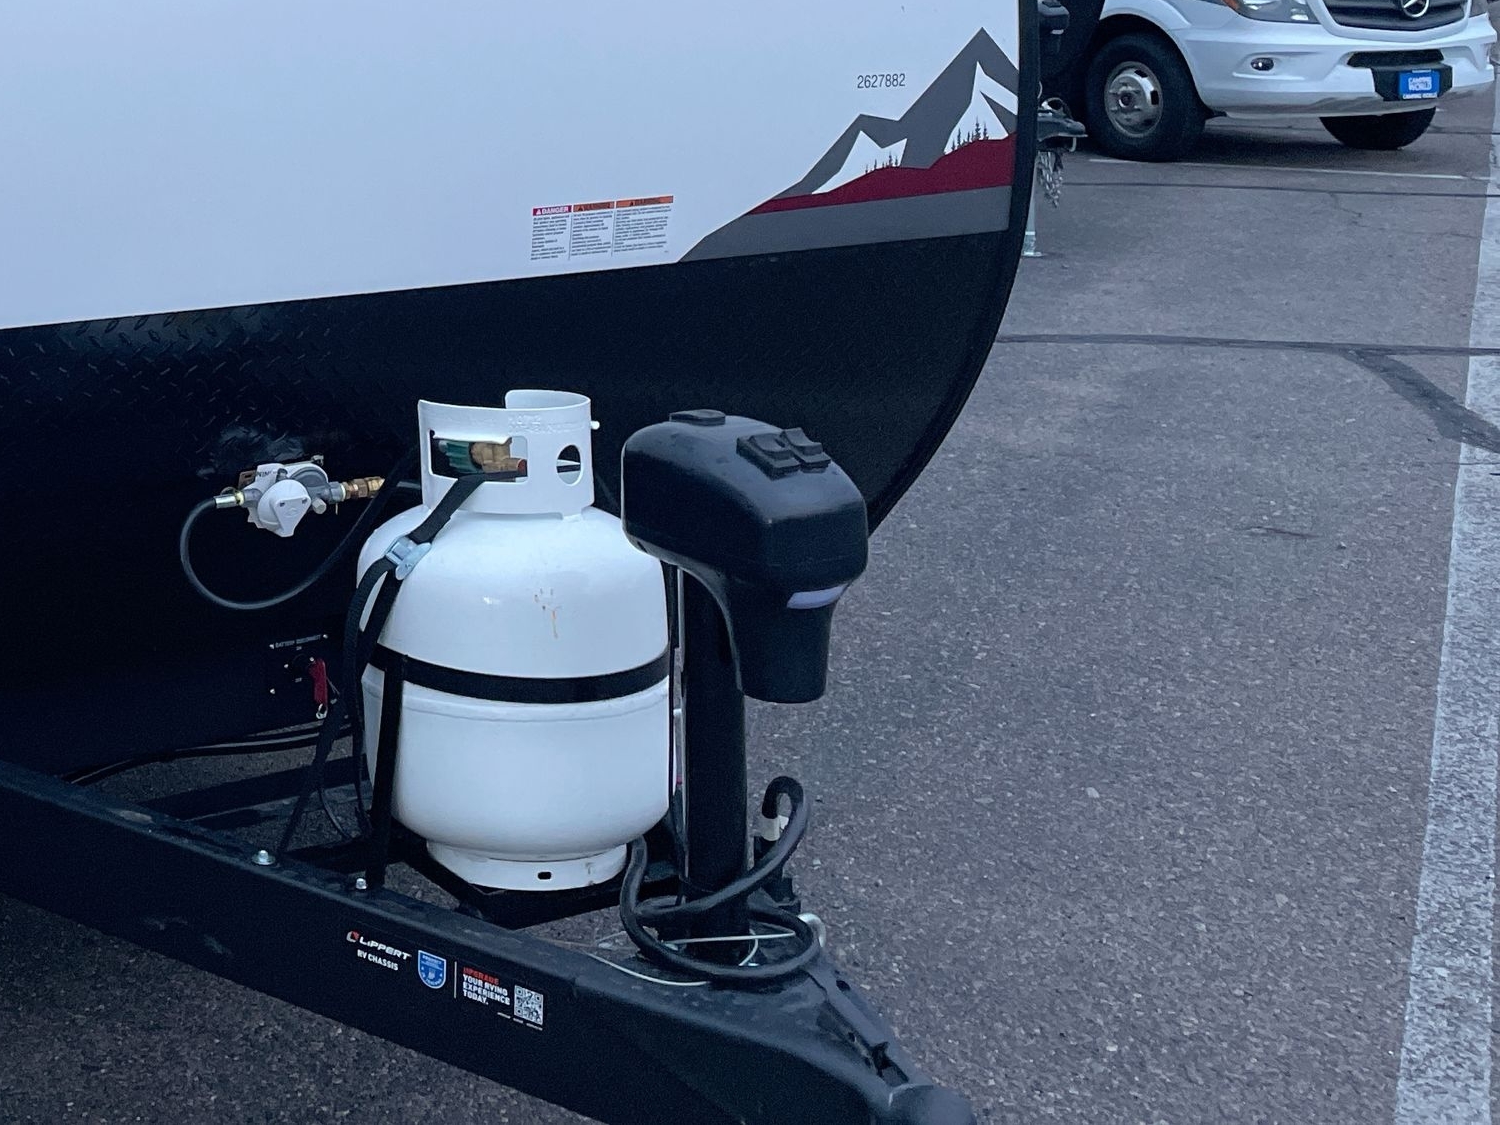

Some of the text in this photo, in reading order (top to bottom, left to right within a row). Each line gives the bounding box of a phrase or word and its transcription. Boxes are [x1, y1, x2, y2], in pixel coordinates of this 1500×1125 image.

[857, 73, 906, 88] 2627882
[541, 206, 569, 216] DANGER
[359, 936, 412, 960] LIPPERT
[357, 949, 398, 970] RV CHASSIS
[463, 966, 499, 985] UPGRADE
[463, 974, 508, 996] YOUR RVING
[463, 981, 511, 1005] EXPERIENCE
[463, 989, 489, 1005] TODAY.
